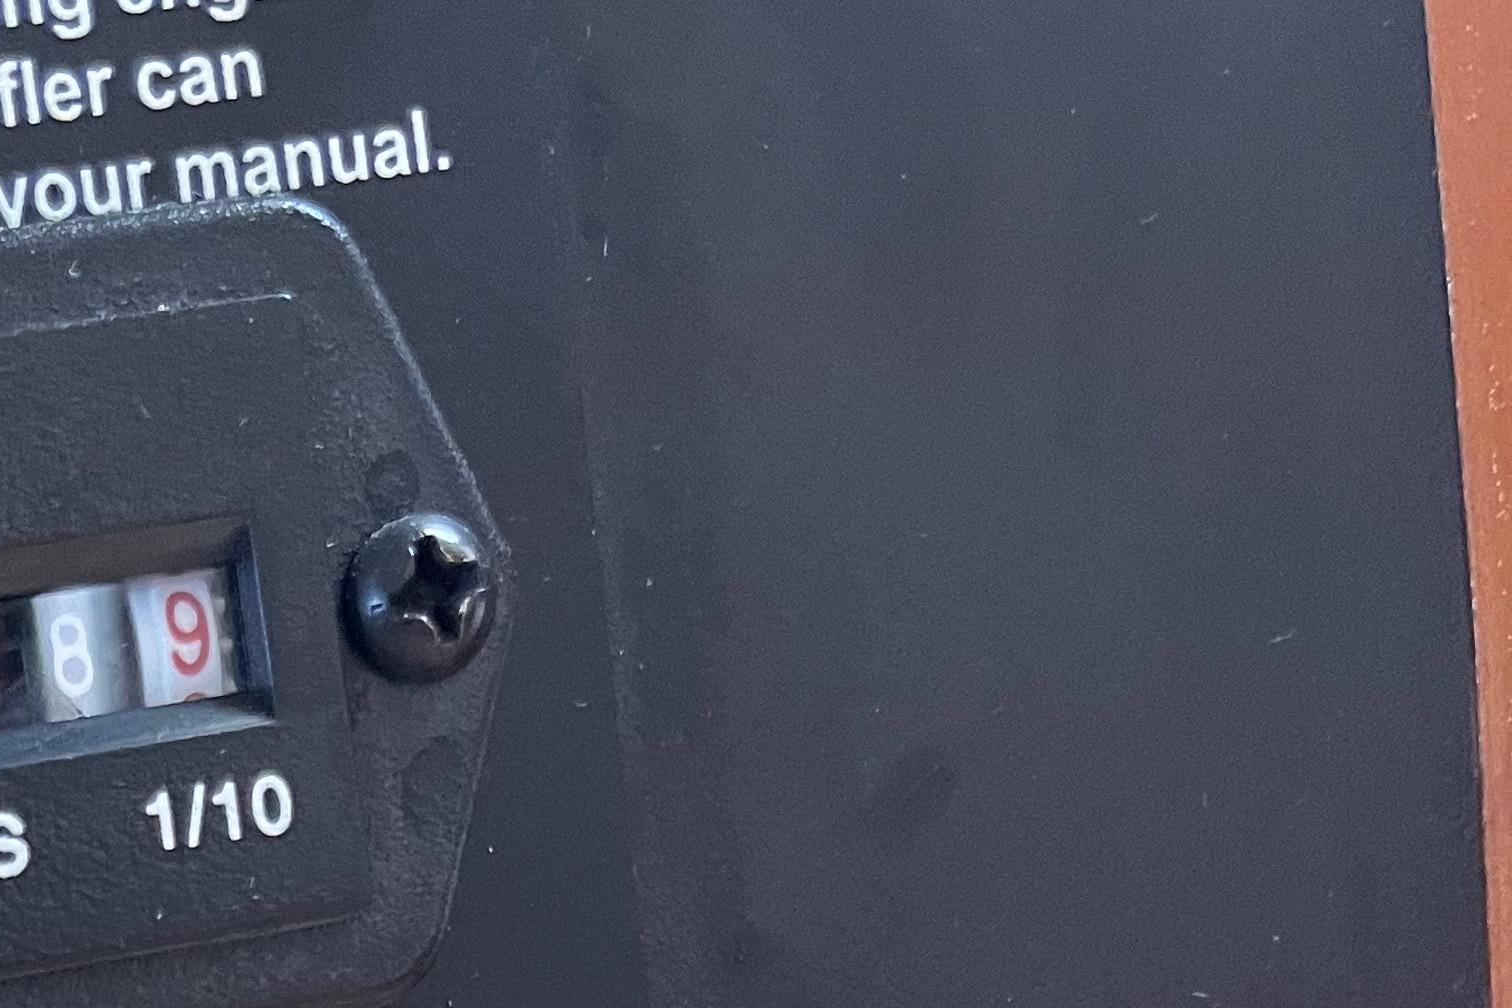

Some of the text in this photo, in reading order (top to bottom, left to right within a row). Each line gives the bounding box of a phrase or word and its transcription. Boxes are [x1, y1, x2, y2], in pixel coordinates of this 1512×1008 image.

[136, 48, 263, 110] can
[174, 107, 451, 206] manual.
[145, 772, 293, 851] 1/10
